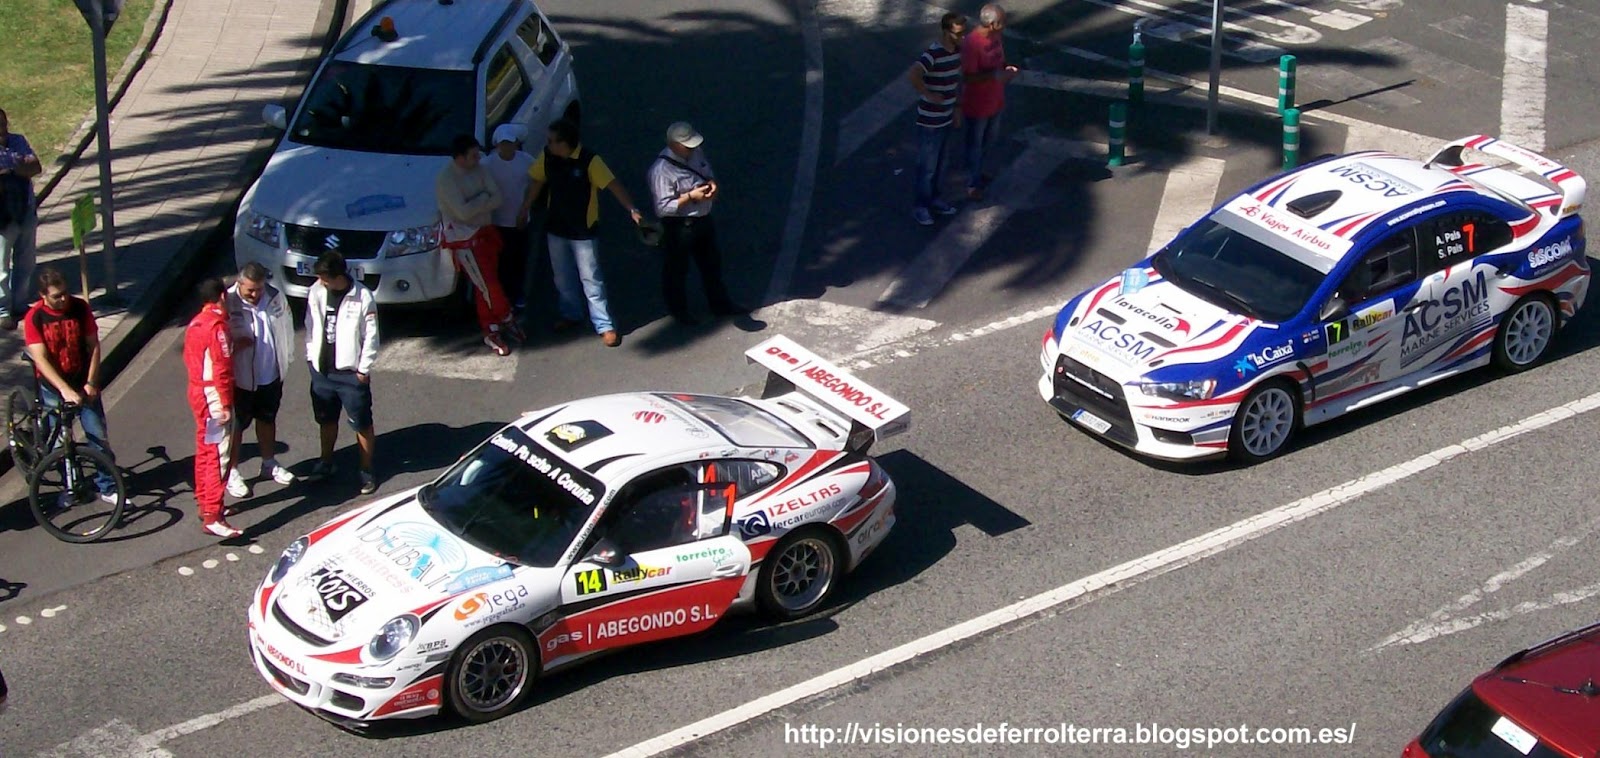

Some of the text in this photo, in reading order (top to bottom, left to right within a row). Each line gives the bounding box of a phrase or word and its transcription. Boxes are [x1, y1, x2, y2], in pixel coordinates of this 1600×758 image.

[1260, 212, 1331, 251] Viajes Airbus
[1462, 223, 1476, 254] 7
[1114, 297, 1175, 330] lavacolla
[1401, 270, 1489, 347] ACSM
[1444, 300, 1491, 331] SERVICES
[1082, 319, 1156, 360] ACSM
[1332, 320, 1342, 343] 7
[800, 365, 872, 407] ABEGONDO
[546, 467, 562, 481] A
[767, 483, 842, 517] IZELTAS
[676, 546, 727, 563] torreiro
[344, 573, 377, 598] HIERROS
[578, 569, 602, 595] 14
[612, 565, 673, 583] Rallycar
[484, 584, 529, 614] jega
[546, 603, 719, 652] gas ABEGONDO S.L.
